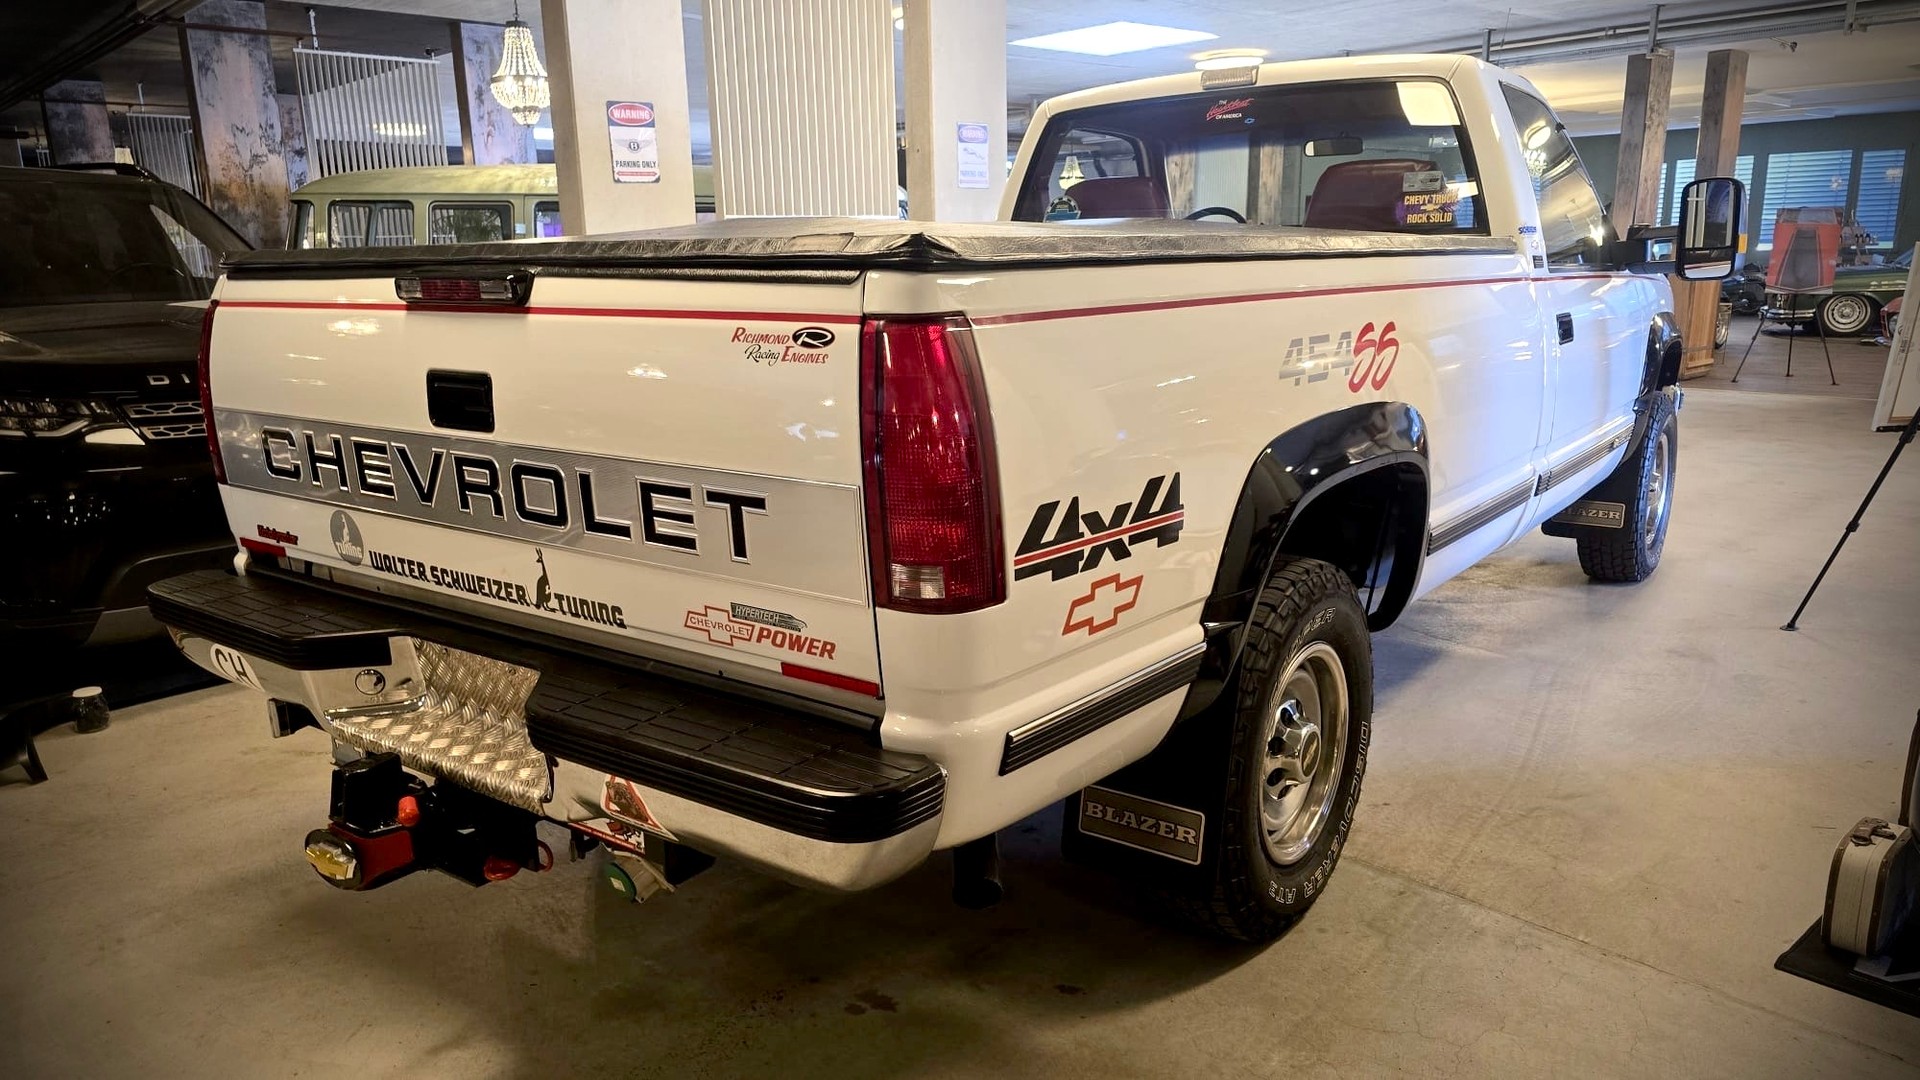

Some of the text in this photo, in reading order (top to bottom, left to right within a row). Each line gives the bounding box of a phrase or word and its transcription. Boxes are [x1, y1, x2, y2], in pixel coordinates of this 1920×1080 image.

[612, 109, 651, 120] WARNING
[615, 160, 657, 168] PARKING ONLY
[1404, 194, 1430, 205] CHEVY
[1406, 212, 1452, 224] ROCK SOLID
[744, 343, 780, 367] Racing
[259, 424, 769, 565] CHEVROLET
[1562, 507, 1621, 519] LAZER
[368, 550, 628, 630] WALTER SCHWEIZER TUNING
[734, 605, 779, 623] HYPERTECH
[688, 615, 750, 637] CHEVROLET
[756, 626, 837, 660] POWER
[215, 648, 261, 690] CH
[1302, 720, 1369, 899] DISCOVERER
[1085, 801, 1197, 845] BLAZER
